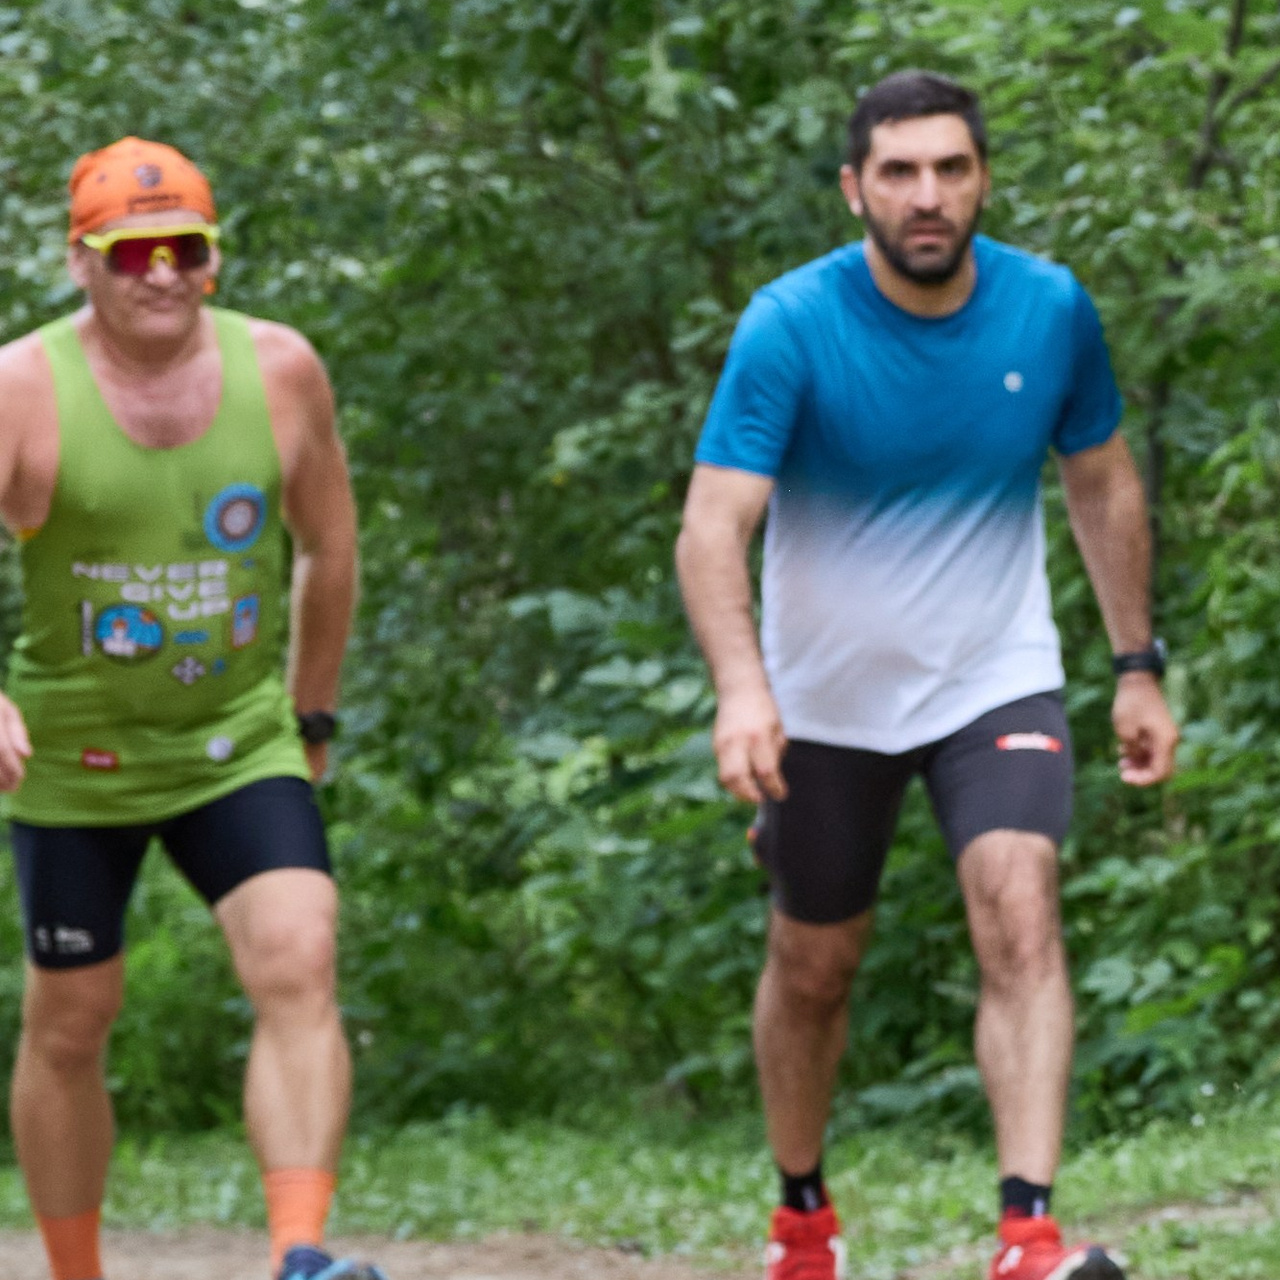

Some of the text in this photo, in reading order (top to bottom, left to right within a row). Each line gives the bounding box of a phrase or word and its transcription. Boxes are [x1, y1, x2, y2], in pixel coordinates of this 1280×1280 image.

[71, 560, 229, 582] NEVER
[120, 580, 227, 602] GIVE
[167, 600, 229, 621] UP
